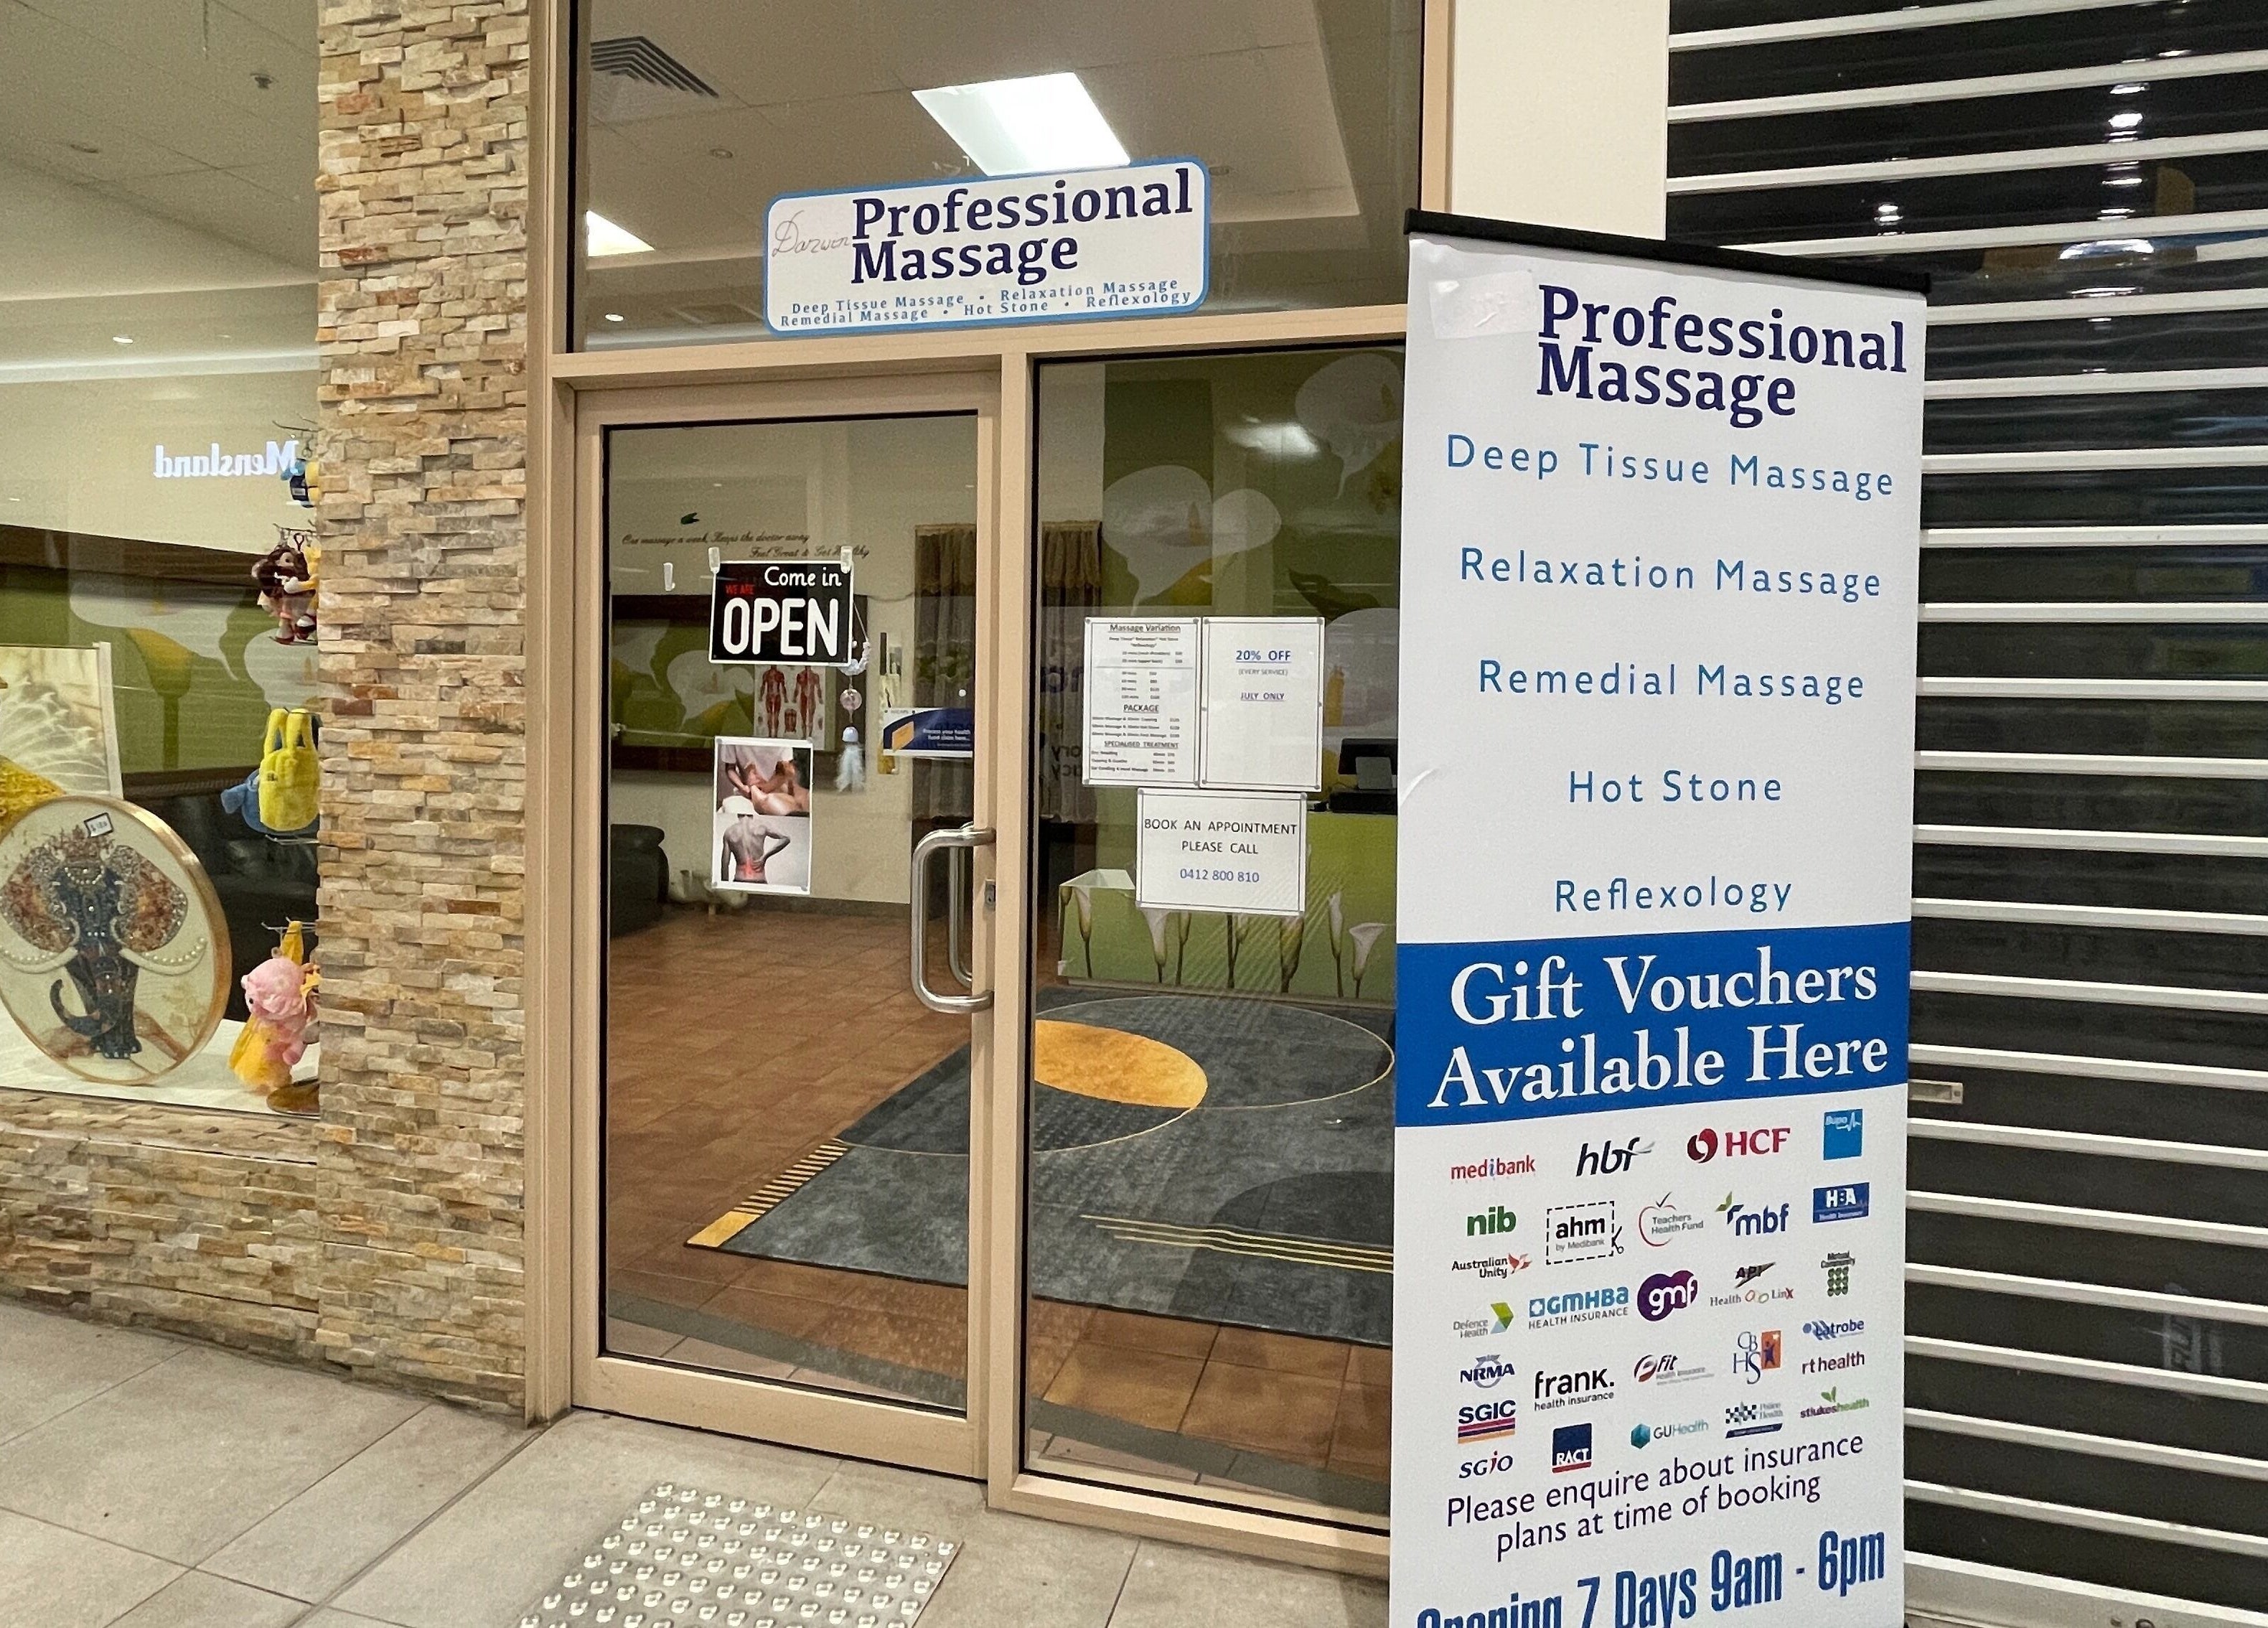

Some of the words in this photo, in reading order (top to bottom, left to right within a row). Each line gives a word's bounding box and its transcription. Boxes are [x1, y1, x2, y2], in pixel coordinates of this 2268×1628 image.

[853, 168, 1192, 239] Professional
[851, 238, 1077, 285] Massage
[780, 312, 853, 327] Remedial
[860, 308, 928, 322] Massage
[964, 303, 992, 316] Hot
[1001, 301, 1049, 314] Stone
[1086, 291, 1191, 308] Reflexology
[792, 303, 828, 315] Deep
[835, 299, 887, 312] Tissue
[895, 294, 963, 308] Massage
[1001, 285, 1095, 301] Relaxation
[1103, 279, 1178, 294] Massage
[1538, 284, 1906, 373] Professional
[1537, 342, 1796, 429] Massage
[1448, 434, 1558, 480] Deep
[1579, 442, 1709, 484] Tissue
[1730, 454, 1893, 501] Massage
[764, 566, 815, 586] Come
[823, 567, 842, 586] in
[1461, 547, 1694, 589] Relaxation
[1717, 560, 1880, 603] Massage
[723, 597, 838, 656] OPEN
[1236, 650, 1261, 661] 20%
[1268, 650, 1291, 661] OFF
[1480, 660, 1675, 695] Remedial
[1697, 665, 1864, 705] Massage
[1123, 704, 1159, 713] PACKAGE
[1240, 692, 1259, 701] JULY
[1263, 692, 1285, 701] ONLY
[1569, 771, 1644, 803] Hot
[1663, 769, 1782, 802] Stone
[1144, 818, 1178, 829] BOOK
[1184, 820, 1201, 831] AN
[1208, 821, 1297, 835] APPOINTMENT
[1181, 841, 1223, 853] PLEASE
[1230, 843, 1259, 854] CALL
[1180, 869, 1209, 880] 0412
[1212, 870, 1234, 881] 800
[1237, 871, 1260, 883] 810
[1556, 876, 1792, 912] Reflexology
[1451, 955, 1583, 1025] Gift
[1603, 946, 1878, 1015] Vouchers
[1428, 1026, 1725, 1108] Available
[1745, 1023, 1888, 1082] Here
[1725, 1128, 1791, 1157] HCF
[1451, 1155, 1535, 1179] medibank
[1575, 1137, 1641, 1177] hbf
[1467, 1206, 1517, 1236] nib
[1555, 1216, 1606, 1239] ahm
[1651, 1223, 1680, 1235] Health
[1681, 1220, 1704, 1231] Fund
[1652, 1214, 1692, 1225] Teachers
[1735, 1203, 1789, 1236] mbf
[1568, 1238, 1605, 1250] Medibank
[1451, 1258, 1508, 1271] Australian
[1479, 1266, 1508, 1279] Unity
[1710, 1294, 1742, 1306] Health
[1453, 1319, 1489, 1331] Defence
[1528, 1316, 1567, 1329] HEALTH
[1570, 1306, 1629, 1323] INSURANCE
[1460, 1327, 1489, 1339] Health
[1460, 1362, 1516, 1383] NRMA
[1458, 1400, 1516, 1424] SGIC
[1534, 1398, 1565, 1411] health
[1568, 1391, 1615, 1405] insurance
[1556, 1447, 1589, 1465] RACT
[1448, 1492, 1534, 1527] Please
[1546, 1471, 1649, 1509] enquire
[1659, 1455, 1734, 1487] about
[1744, 1436, 1863, 1472] insurance
[1497, 1521, 1567, 1563] plans
[1578, 1513, 1603, 1537] at
[1614, 1502, 1672, 1530] time
[1682, 1486, 1710, 1517] of
[1718, 1474, 1821, 1510] booking
[1418, 1592, 1562, 1628] ning
[1577, 1576, 1601, 1628] 7
[1615, 1568, 1697, 1628] Days
[1711, 1549, 1783, 1612] 9am
[1818, 1530, 1885, 1597] 6pm
